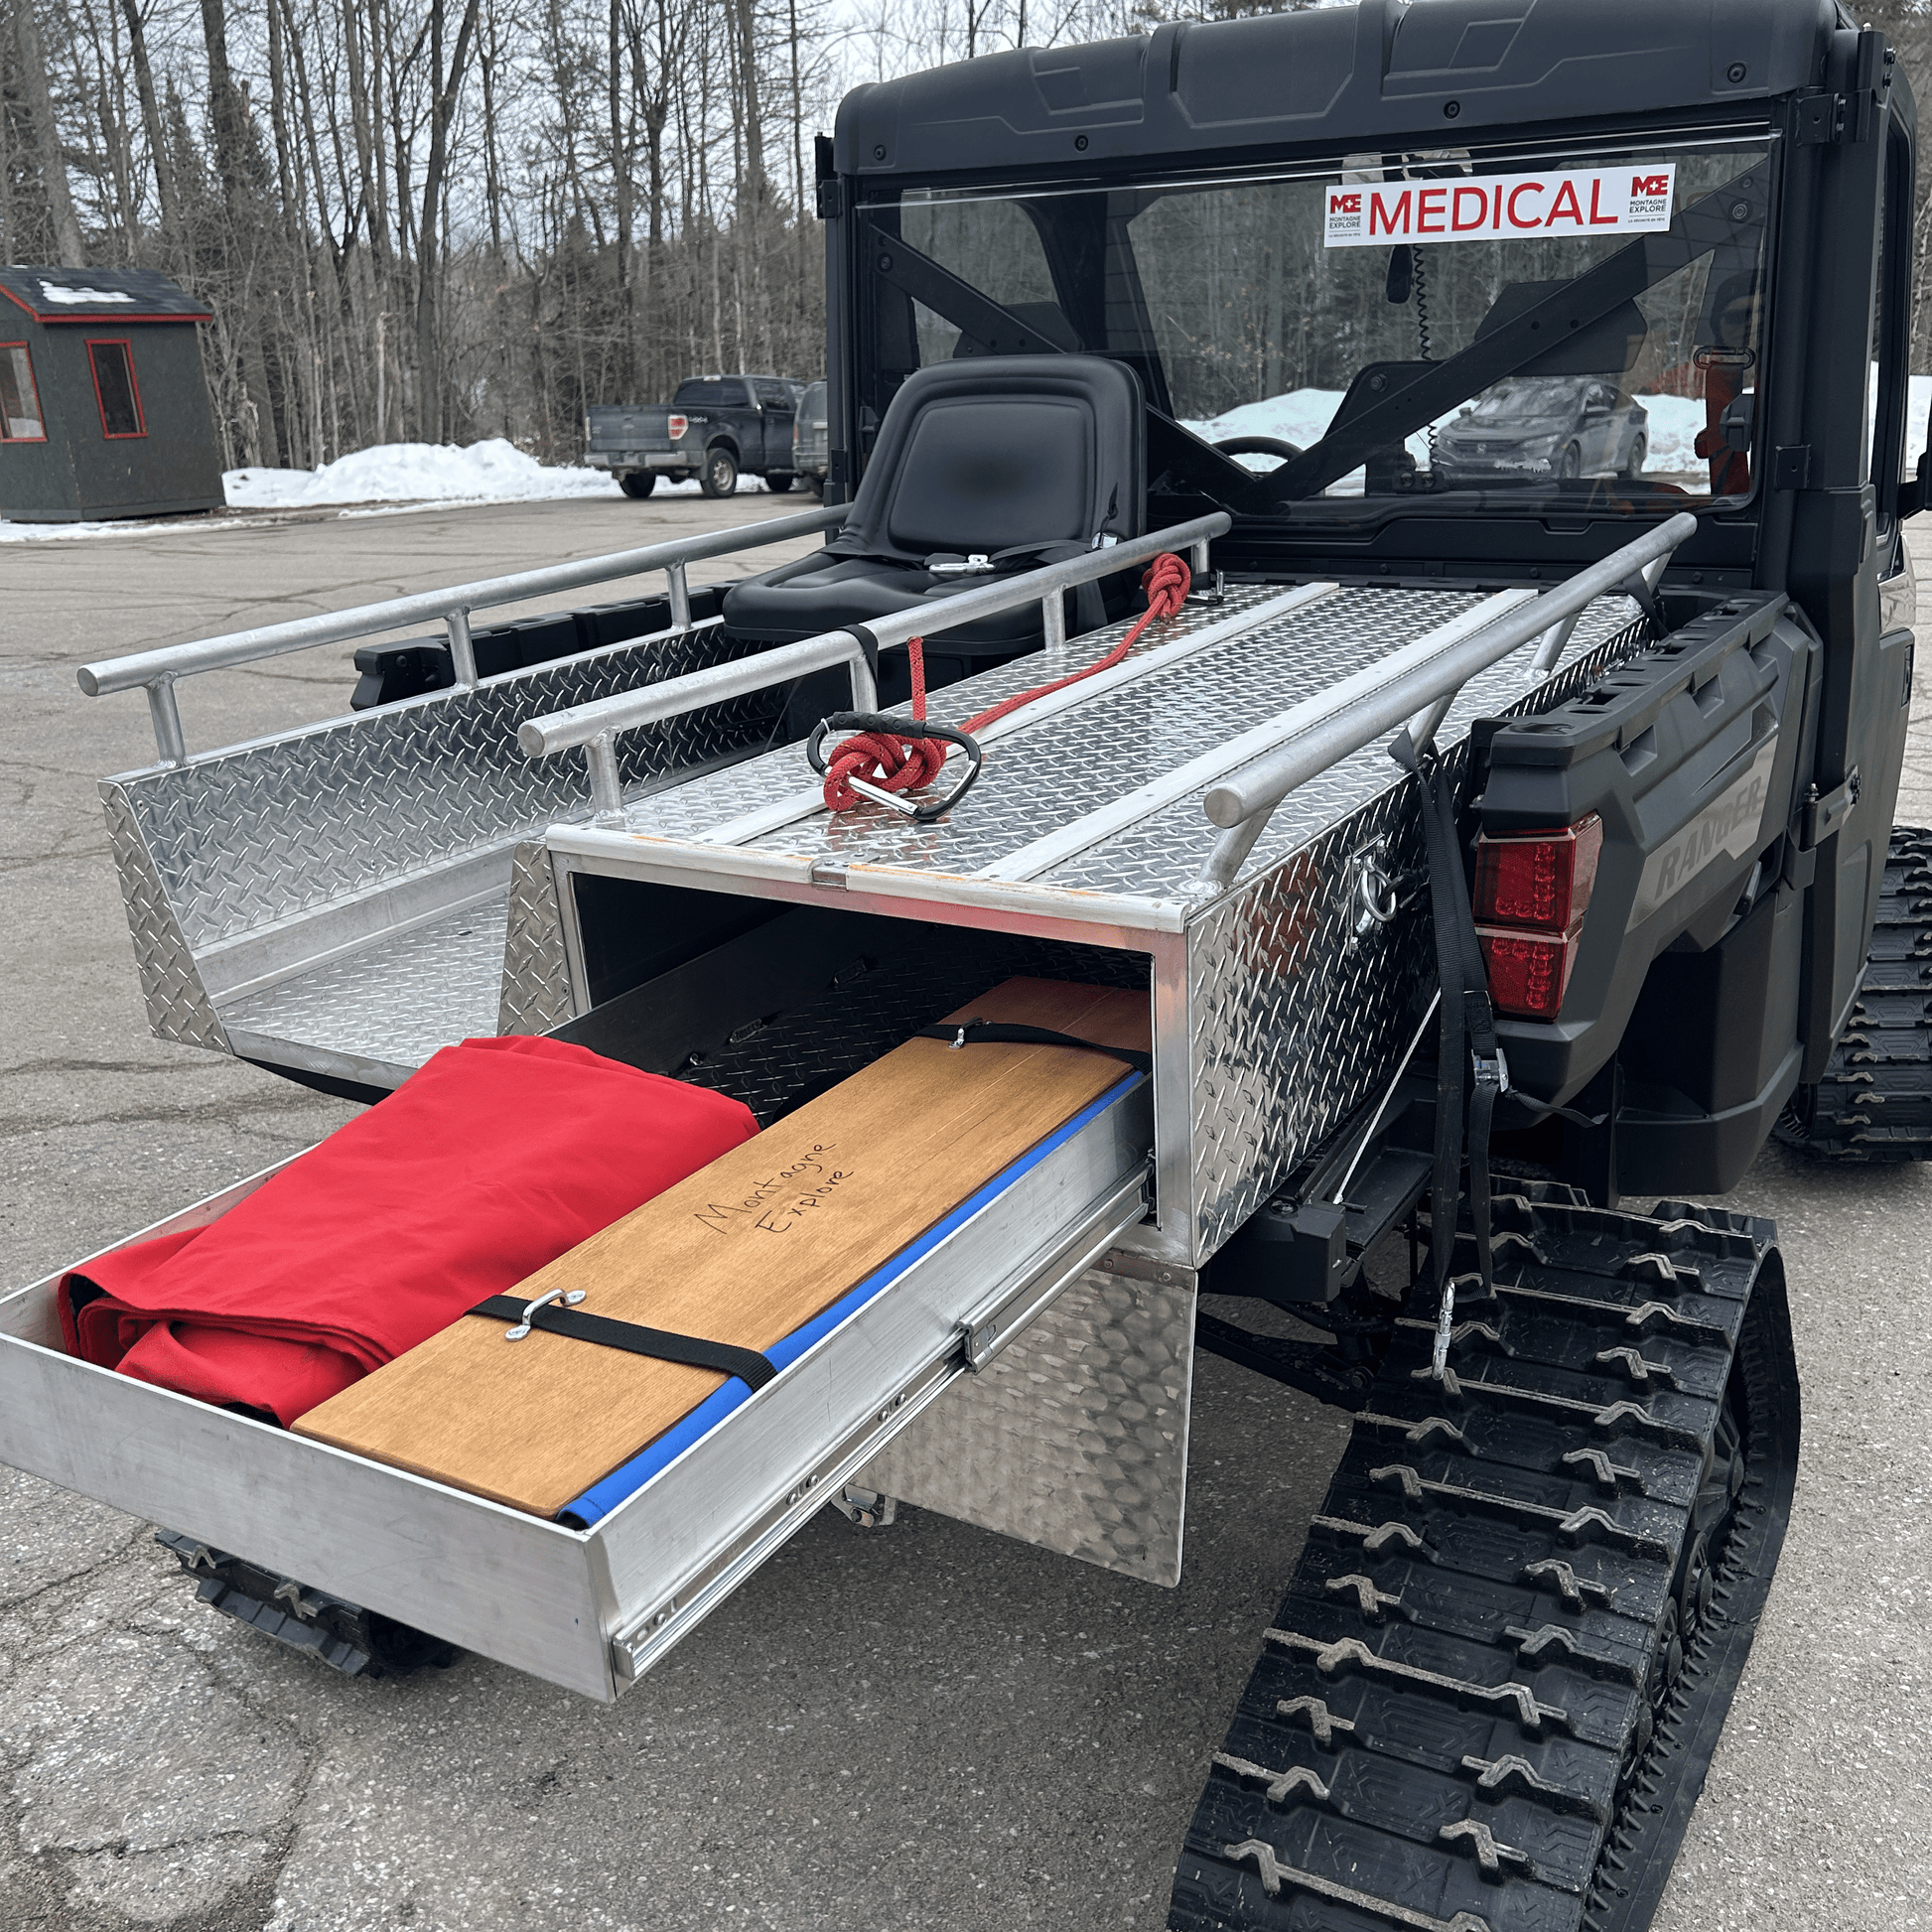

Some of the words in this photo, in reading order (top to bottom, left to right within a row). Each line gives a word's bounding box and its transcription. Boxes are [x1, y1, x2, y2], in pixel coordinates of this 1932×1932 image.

[1369, 179, 1618, 236] MEDICAL
[1629, 205, 1666, 213] EXPLORE
[1655, 775, 1765, 900] RANGER
[694, 1144, 837, 1234] Montagne
[755, 1171, 855, 1233] Explore
